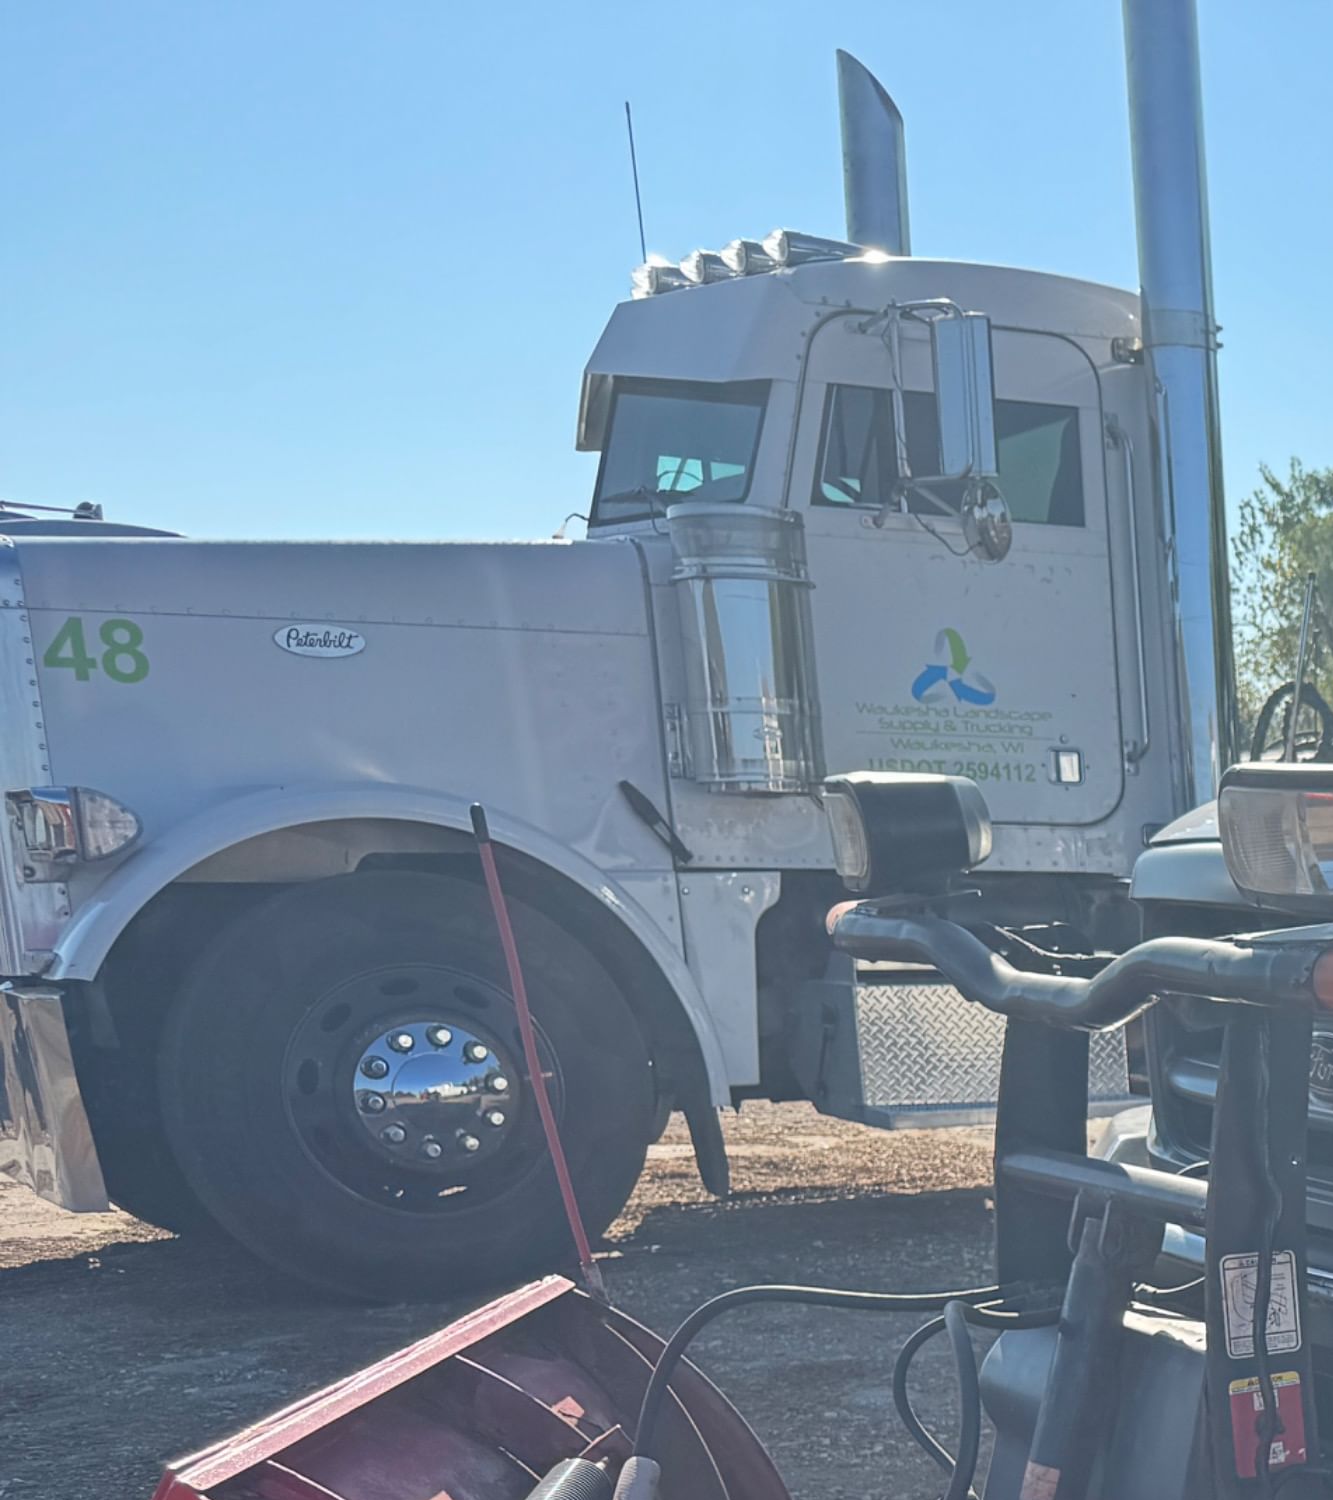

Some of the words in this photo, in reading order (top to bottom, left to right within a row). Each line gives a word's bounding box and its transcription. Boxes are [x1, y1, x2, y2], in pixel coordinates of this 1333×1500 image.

[286, 627, 360, 649] Peterbilt
[42, 616, 150, 684] 48
[855, 702, 950, 718] Waukesha
[953, 706, 1053, 722] Landscape
[878, 718, 940, 733] Supply
[943, 720, 957, 732] &
[961, 721, 1033, 737] Trucking
[1001, 741, 1025, 754] WI
[953, 760, 1037, 782] 2594112
